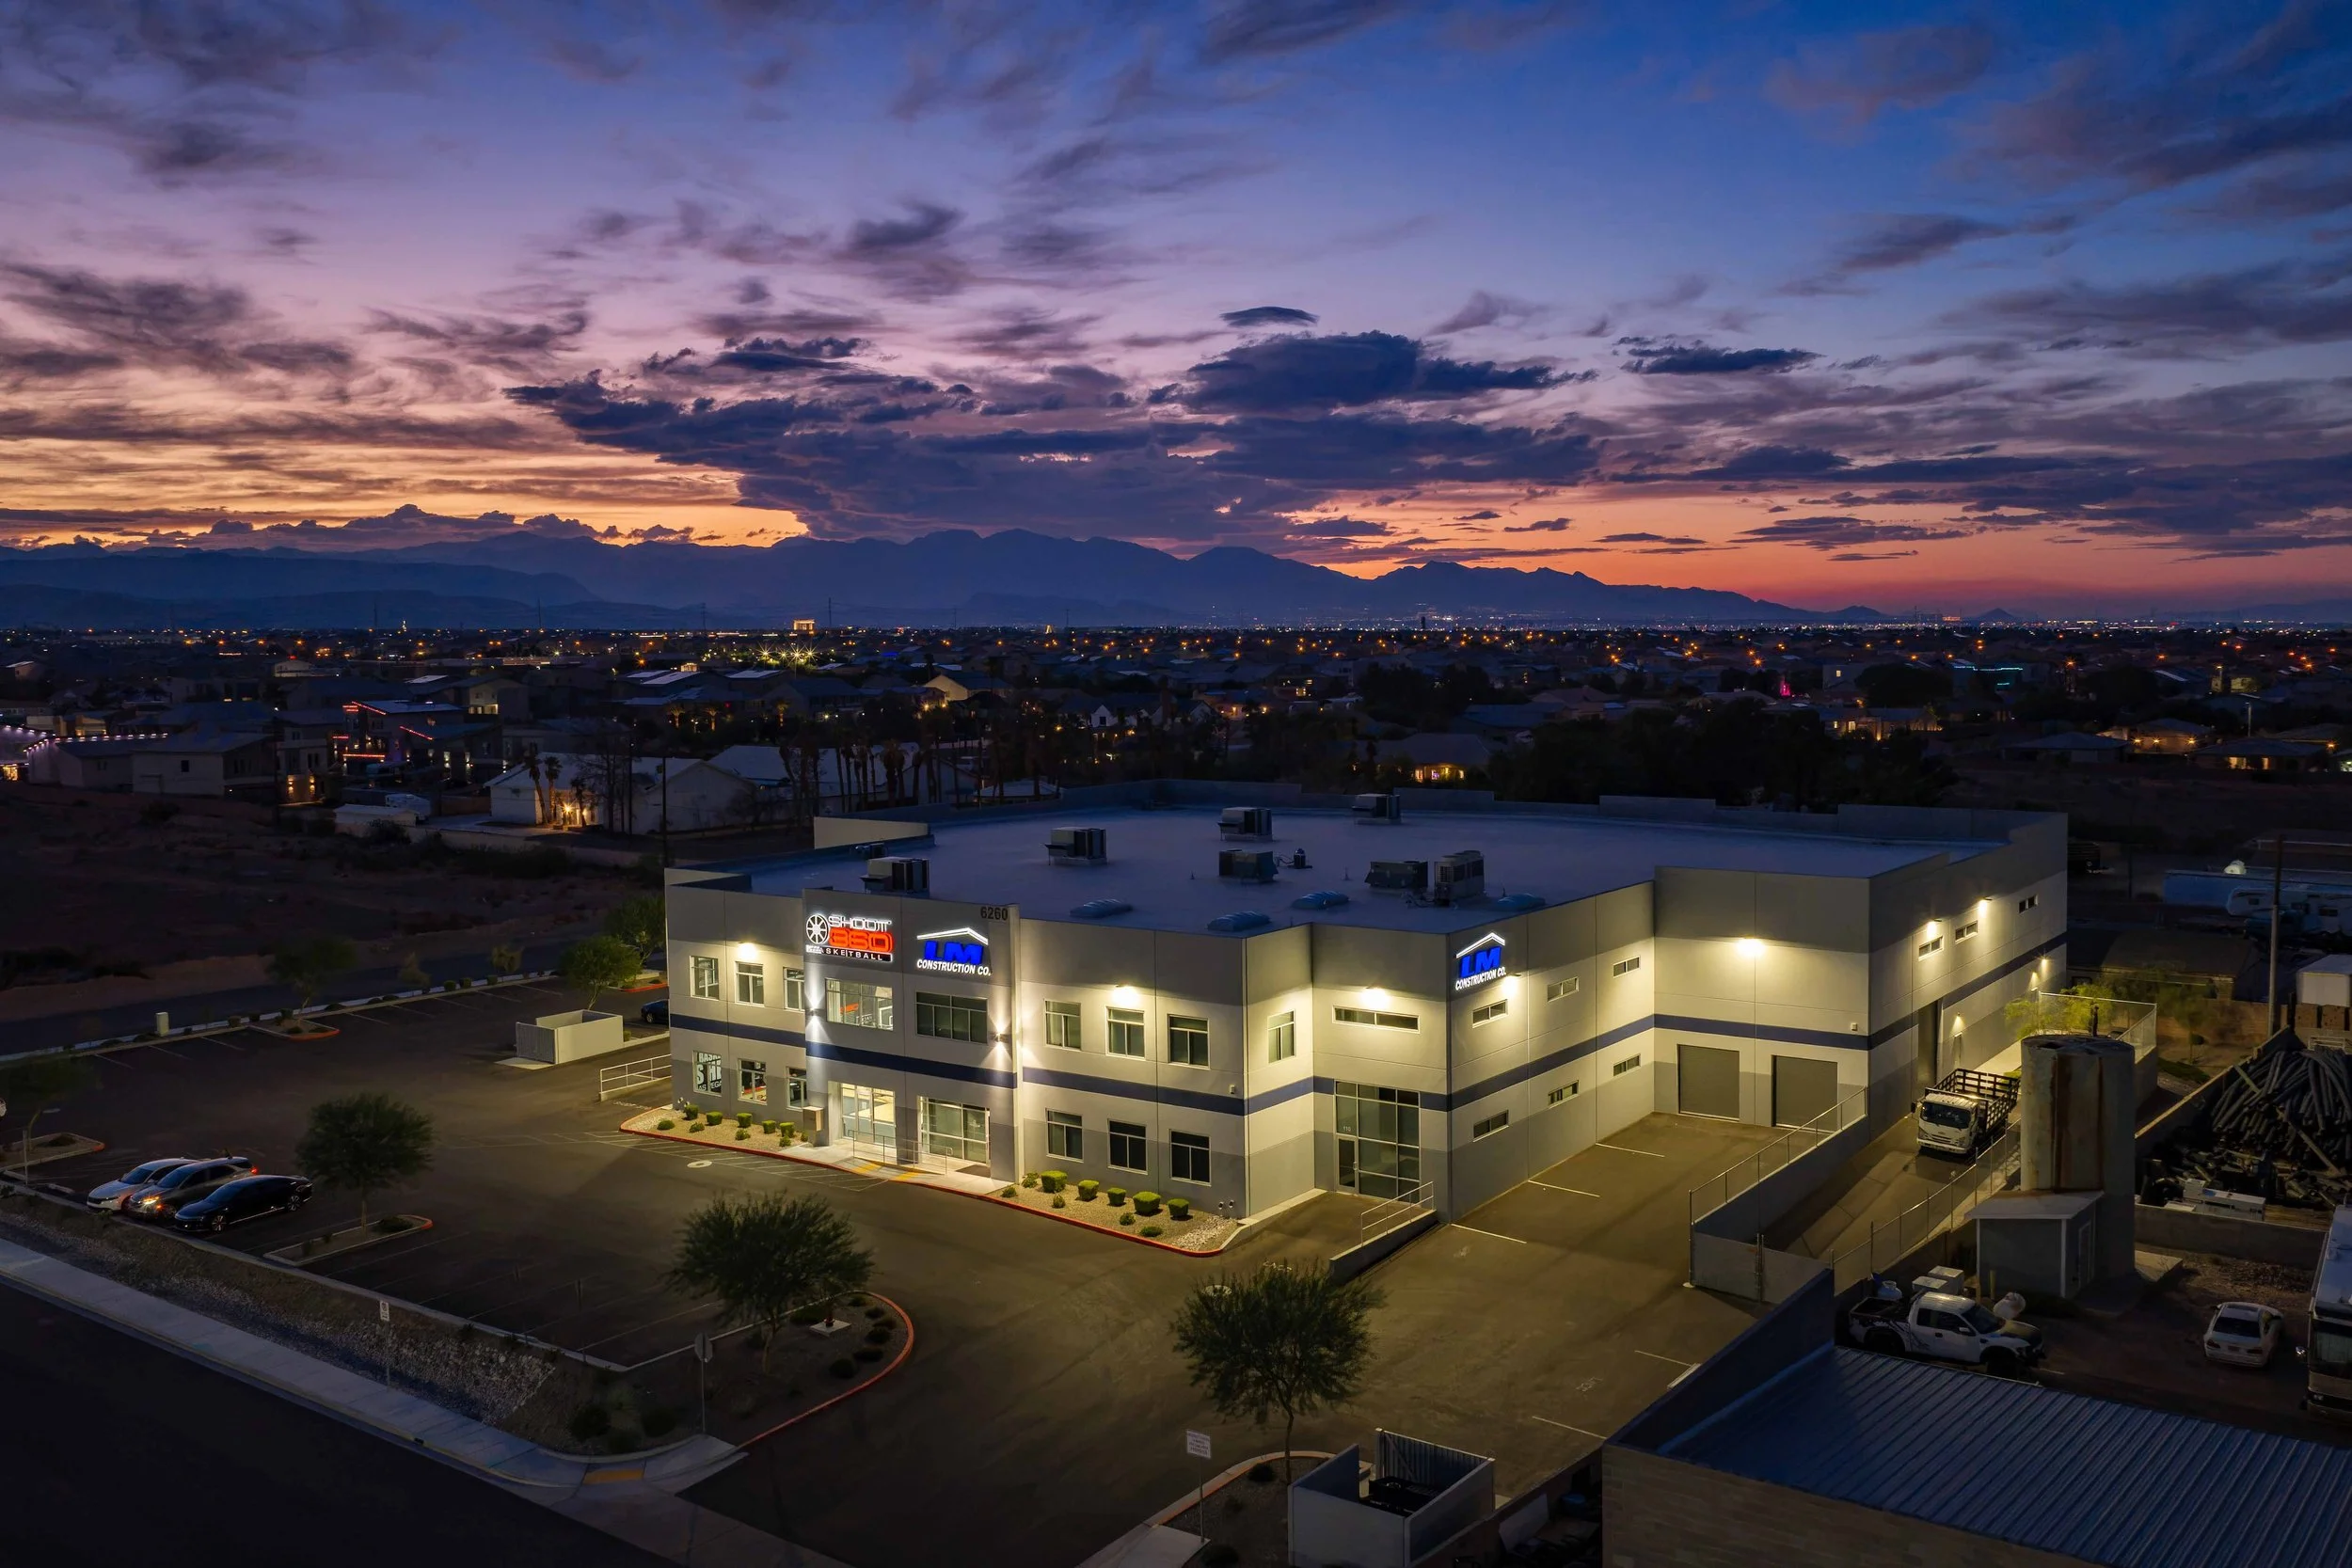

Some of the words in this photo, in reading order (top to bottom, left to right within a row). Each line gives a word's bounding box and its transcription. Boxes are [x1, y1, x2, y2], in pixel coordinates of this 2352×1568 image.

[980, 907, 1008, 921] 6260
[828, 927, 893, 953] 360
[924, 940, 983, 965] LM
[1460, 945, 1502, 978] LM
[916, 959, 976, 974] CONSTRUCTION
[977, 966, 992, 976] CO.
[1455, 969, 1497, 990] CONSTRUCTION
[1497, 966, 1506, 977] CO.
